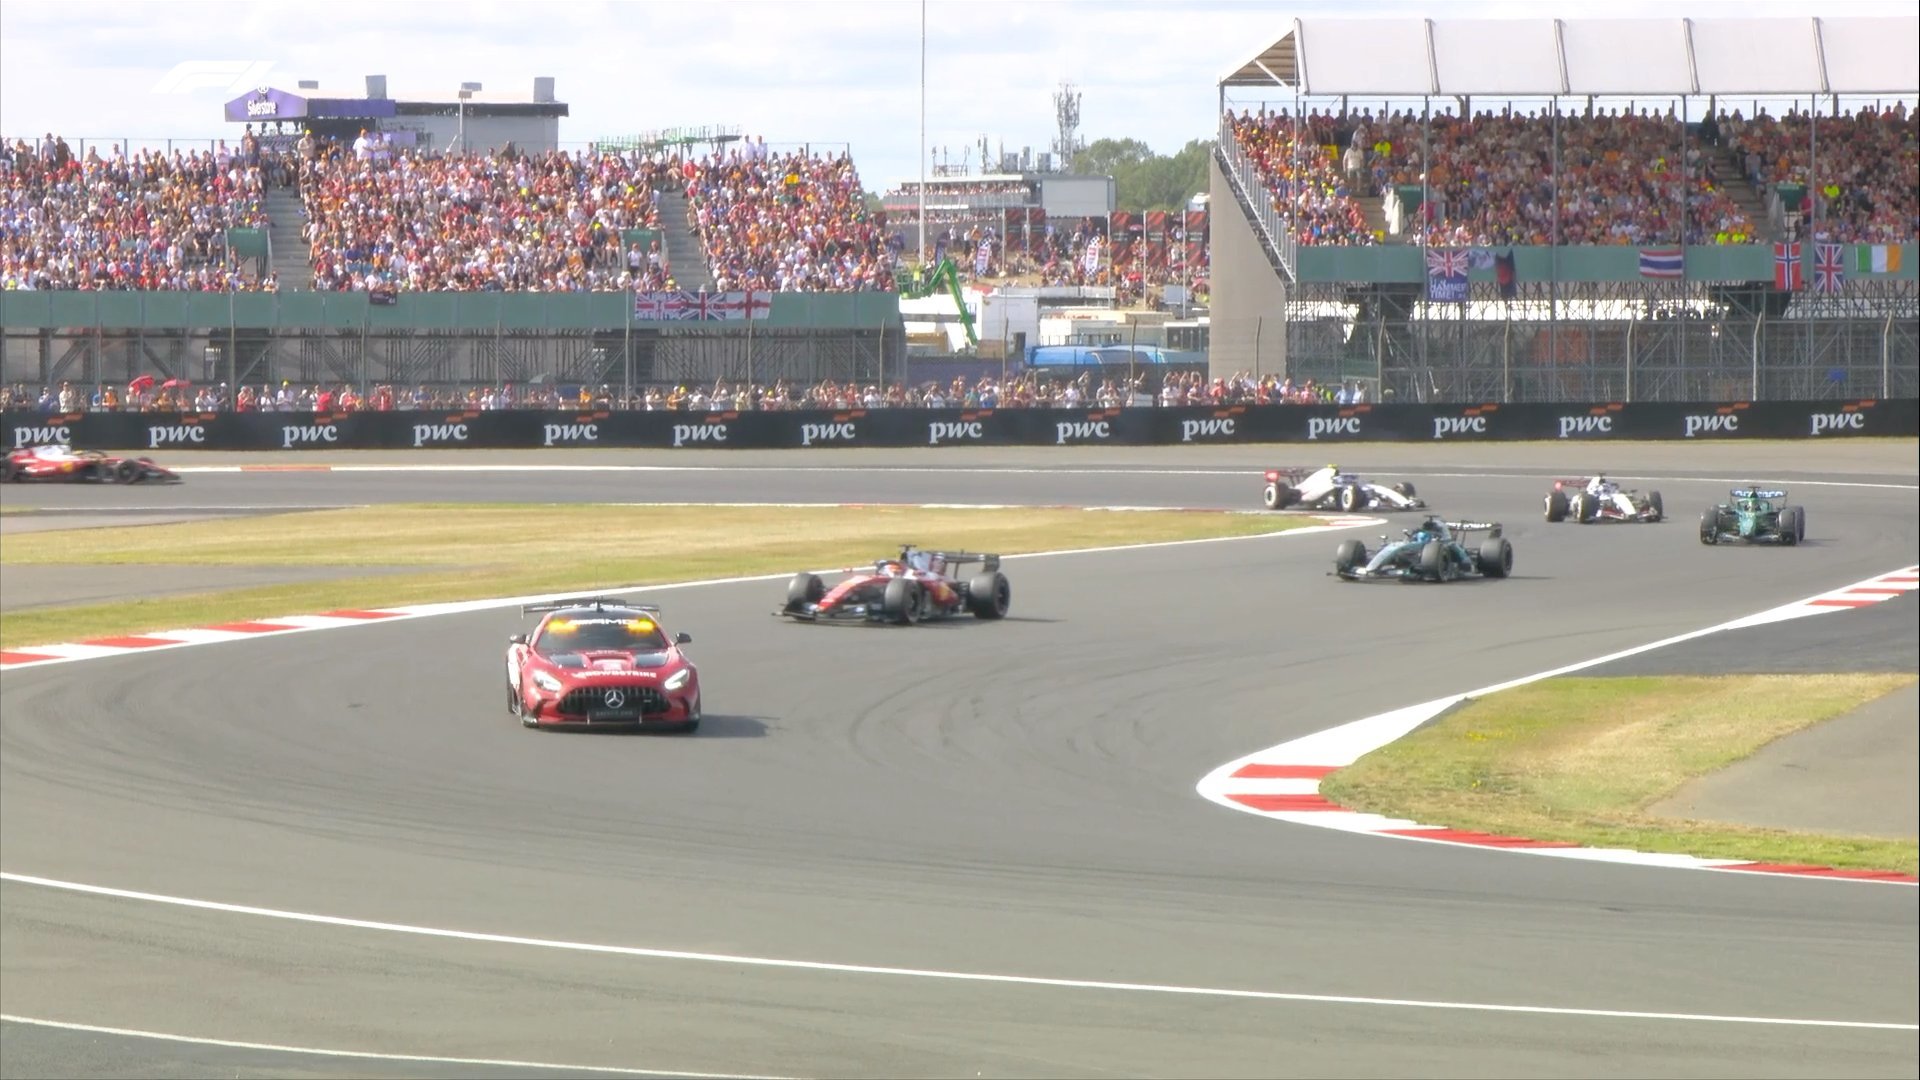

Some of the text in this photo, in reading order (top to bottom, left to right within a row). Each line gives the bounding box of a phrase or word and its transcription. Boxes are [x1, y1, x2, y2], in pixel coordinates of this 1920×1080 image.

[247, 99, 276, 117] Silverstone
[802, 423, 855, 445] pwc
[929, 422, 982, 444] pwc
[1056, 422, 1109, 444] pwc
[1182, 419, 1234, 441] pwc
[1308, 418, 1360, 439] pwc
[1434, 417, 1486, 438] pwc
[1559, 416, 1611, 437] pwc
[1685, 416, 1737, 436] pwc
[1811, 413, 1863, 434] pwc
[14, 427, 71, 448] pwc
[149, 426, 204, 447] pwc
[283, 426, 337, 447] pwc
[413, 424, 467, 446] pwc
[544, 424, 597, 445] pwc
[673, 425, 726, 446] pwc
